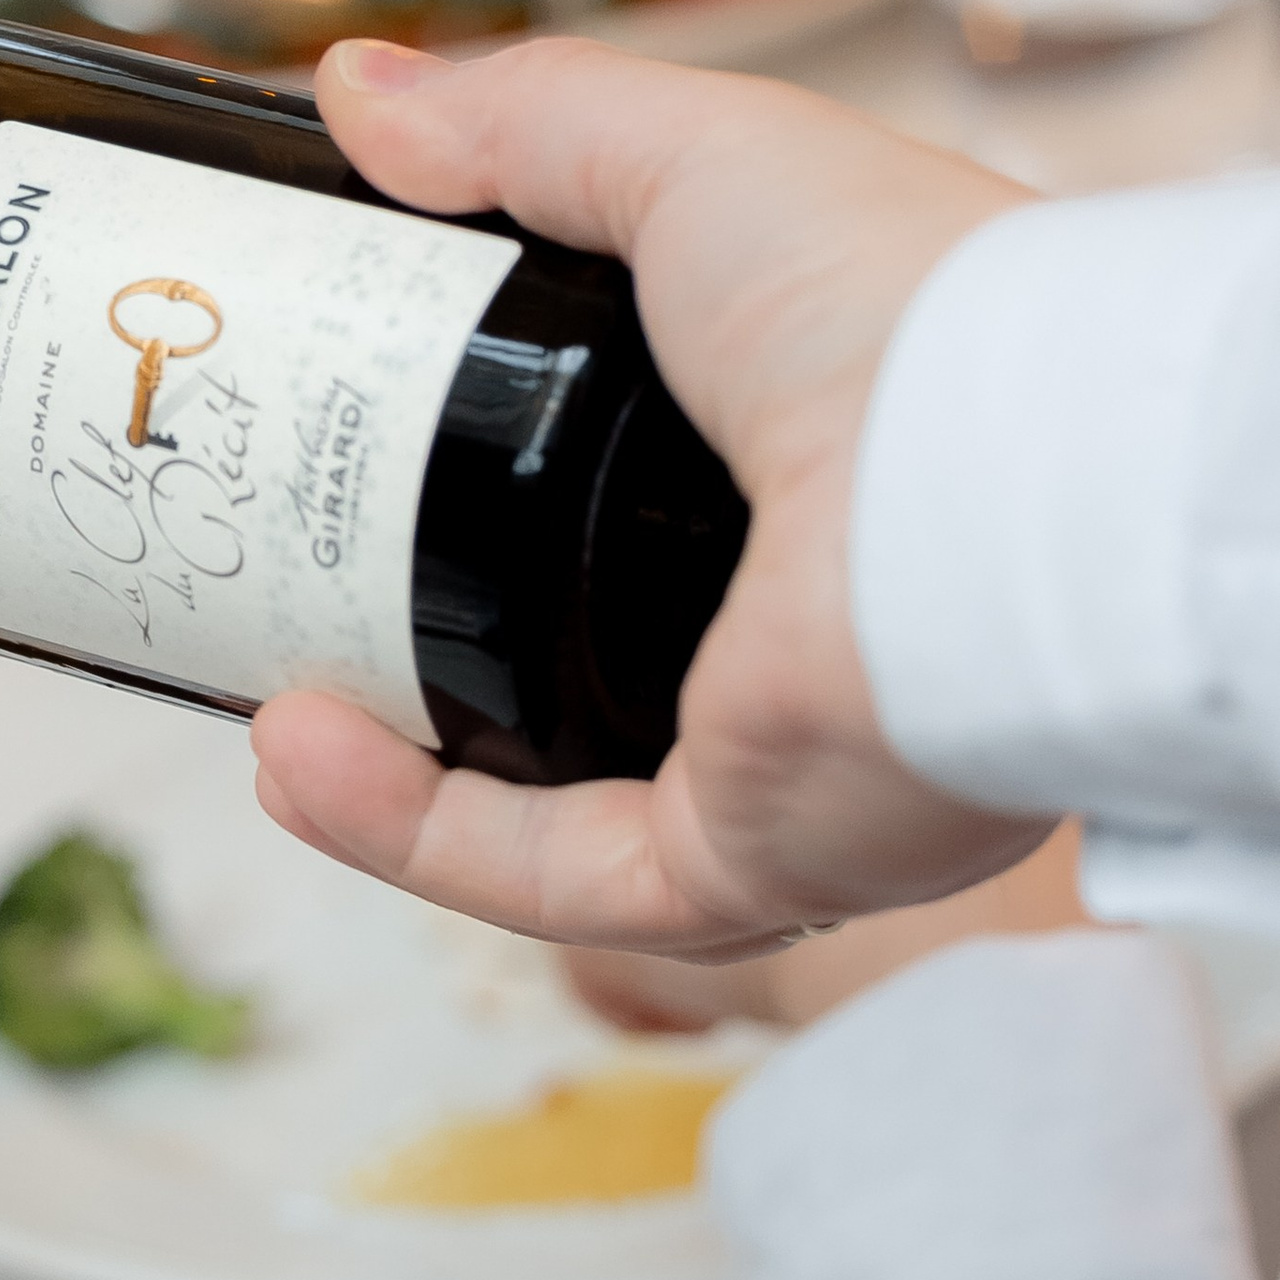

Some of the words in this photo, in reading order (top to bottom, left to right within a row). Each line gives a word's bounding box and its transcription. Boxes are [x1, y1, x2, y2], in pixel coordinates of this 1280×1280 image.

[29, 340, 63, 474] DOMAINE
[150, 368, 261, 578] Récit
[51, 421, 175, 564] Clef
[312, 403, 363, 569] GIRARD
[69, 569, 152, 648] La
[148, 572, 196, 612] du
